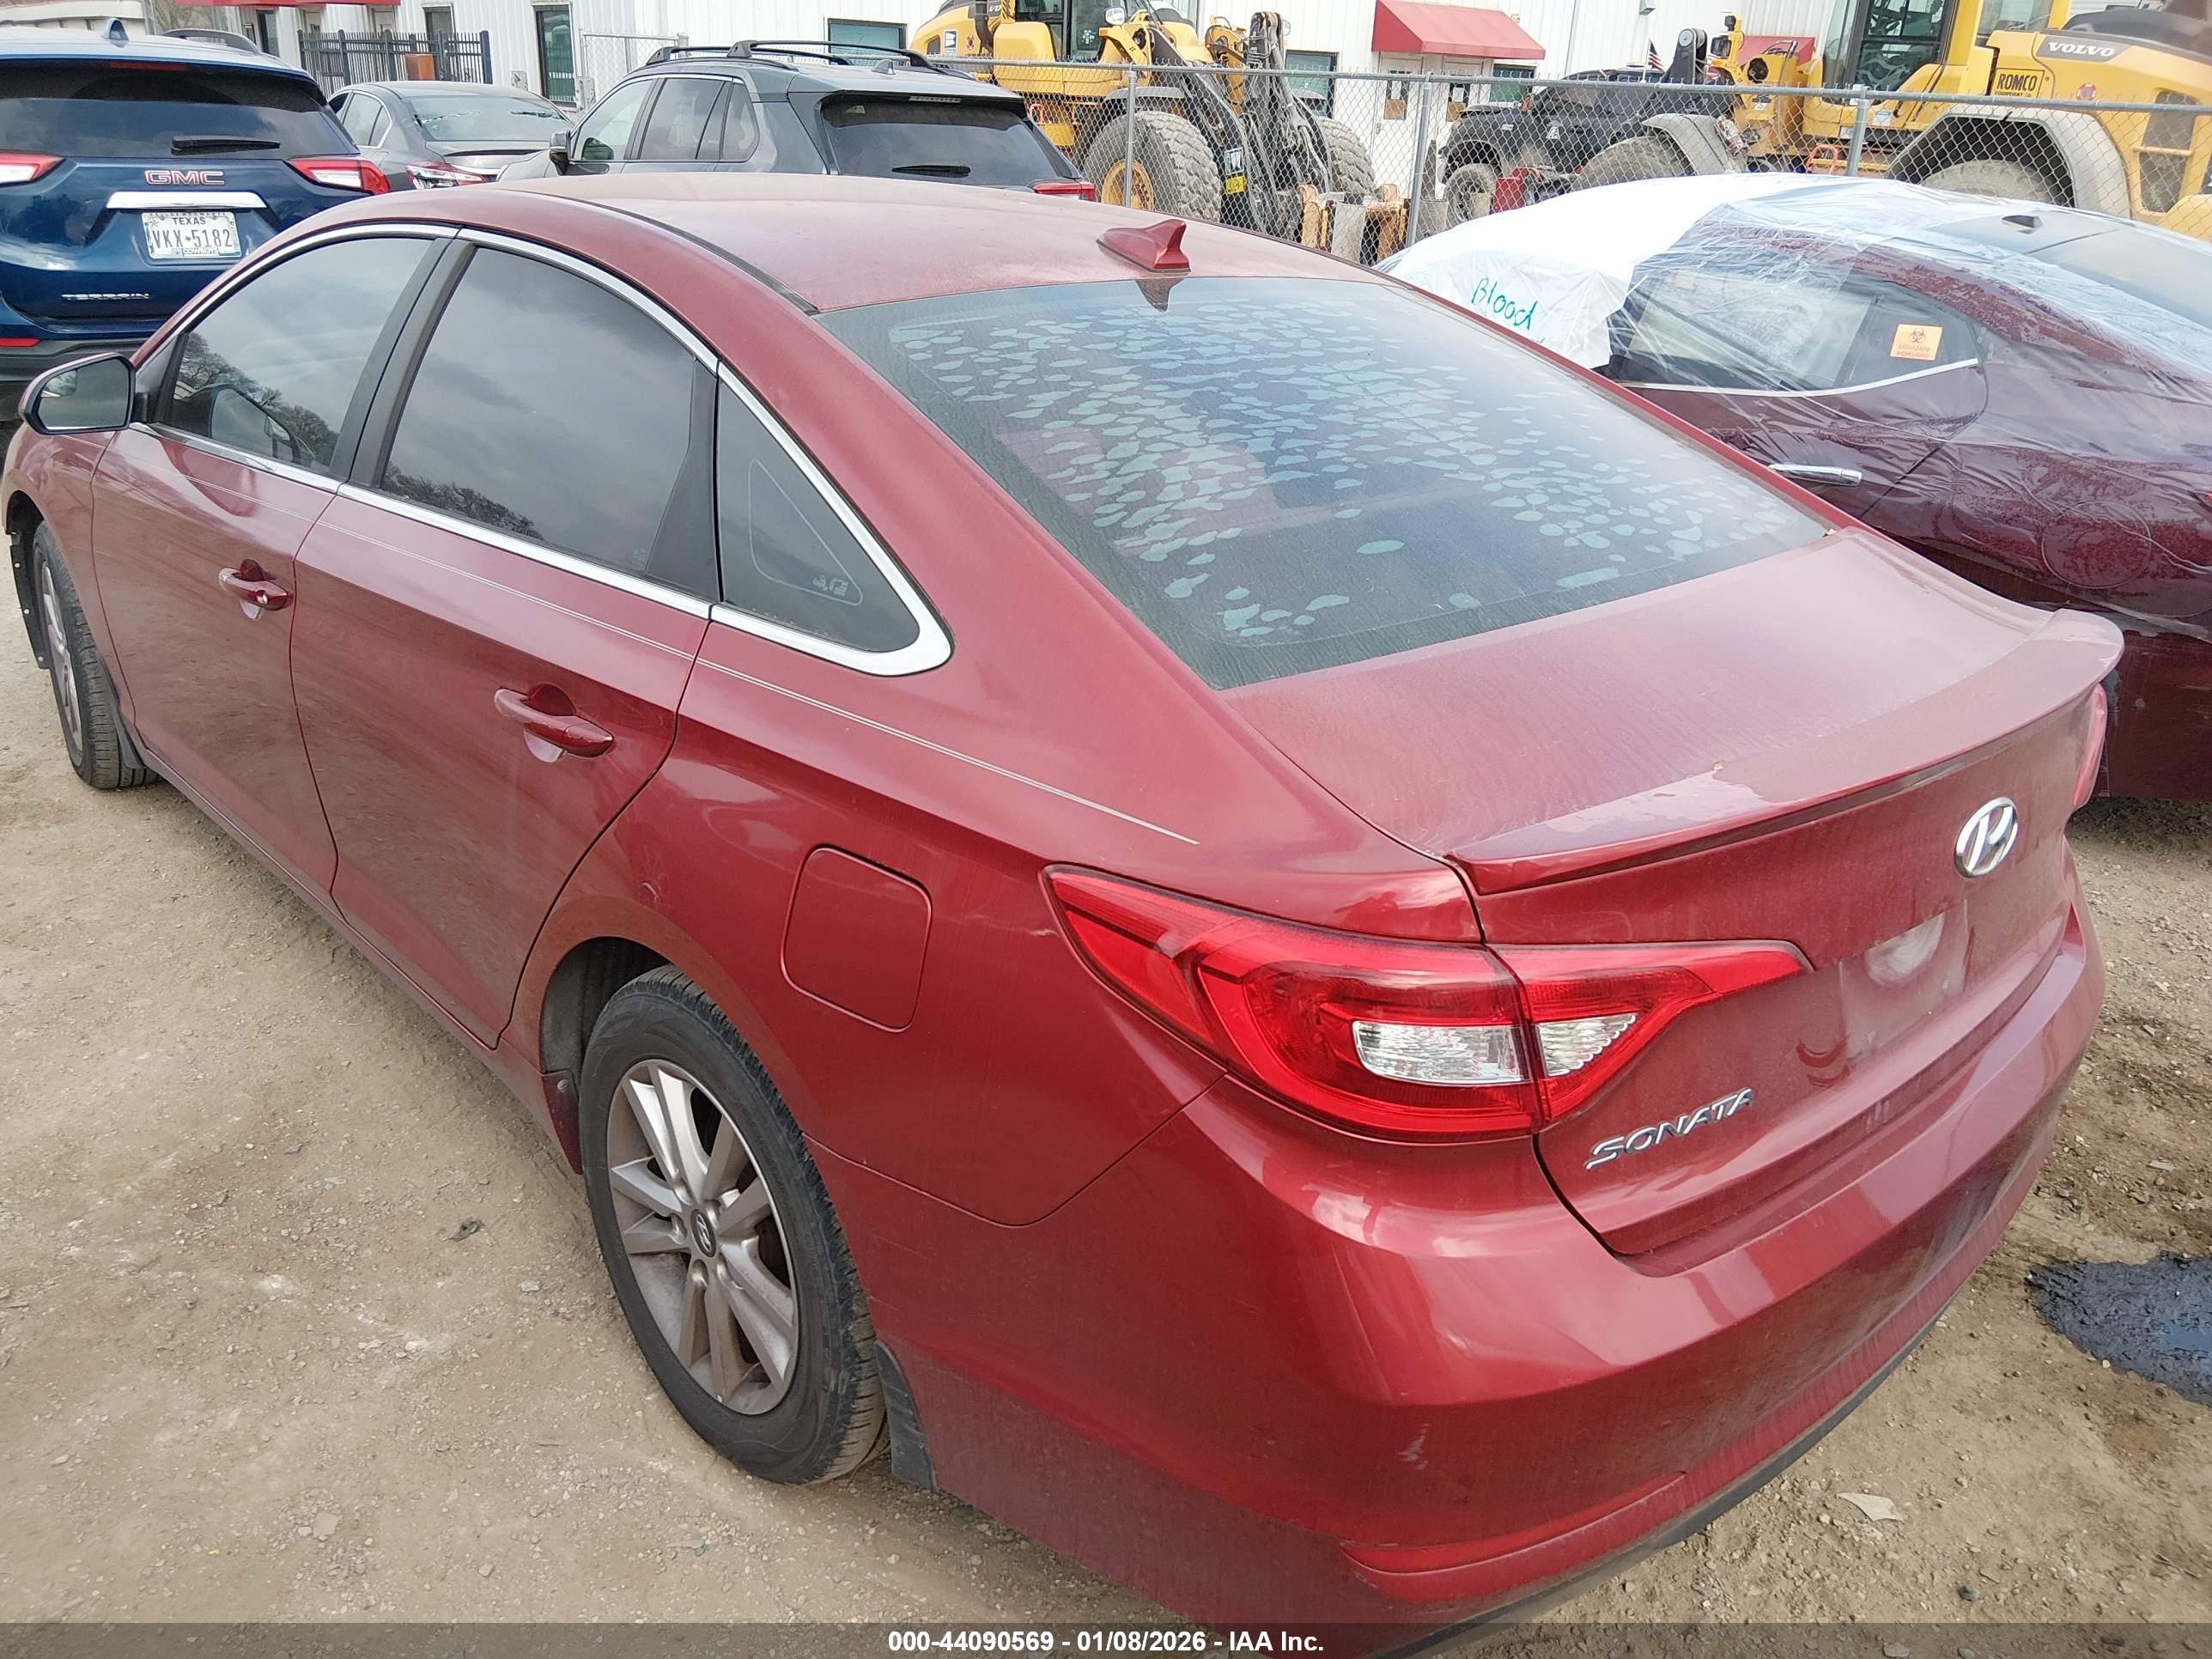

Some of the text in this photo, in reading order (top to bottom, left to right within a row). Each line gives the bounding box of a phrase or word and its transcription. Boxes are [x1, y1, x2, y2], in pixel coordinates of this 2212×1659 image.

[2048, 42, 2117, 57] VOLVO
[1996, 73, 2038, 91] ROMCO
[145, 170, 225, 185] GMC
[1471, 277, 1538, 331] Blood
[1584, 1085, 1753, 1170] SONATA
